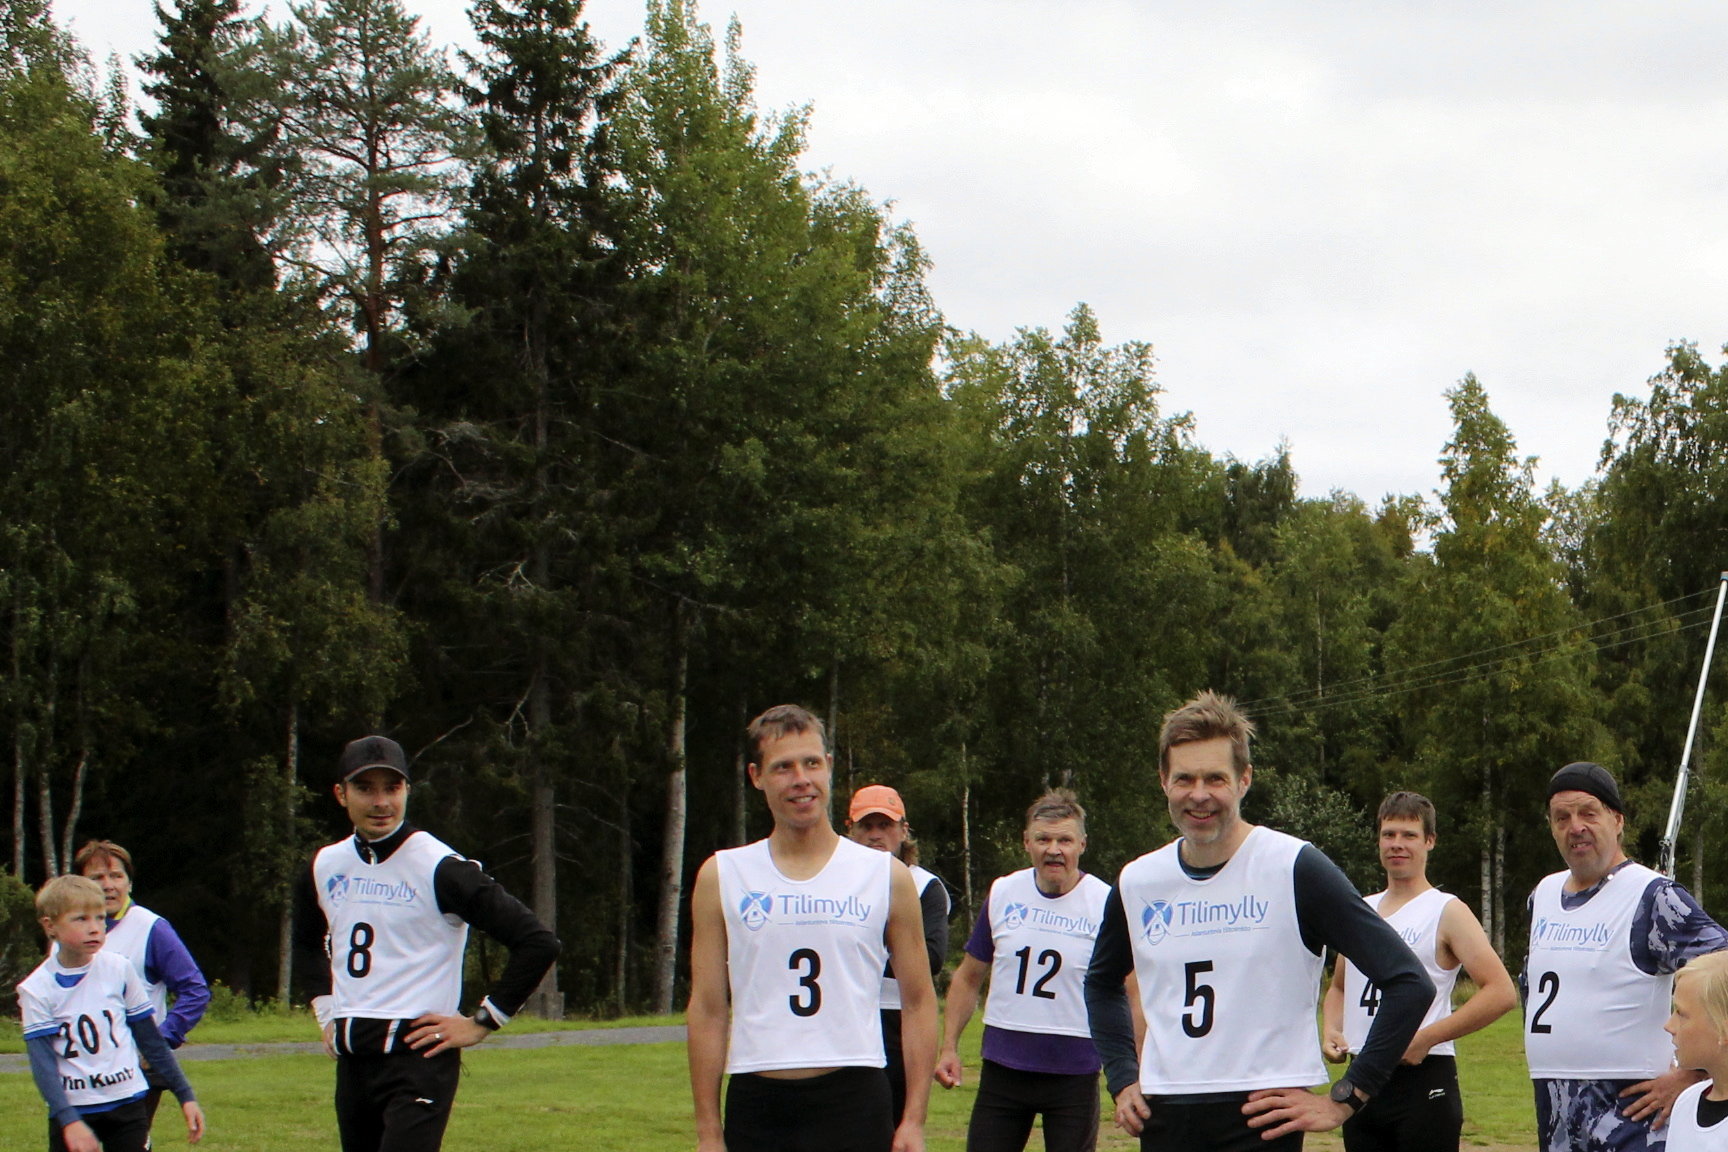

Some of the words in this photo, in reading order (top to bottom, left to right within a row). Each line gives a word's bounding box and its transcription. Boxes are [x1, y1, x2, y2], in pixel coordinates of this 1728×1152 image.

[352, 877, 417, 902] Tilimylly
[778, 894, 871, 921] Tilimylly
[1032, 907, 1097, 934] Tilimylly
[1177, 895, 1269, 925] Tilimylly
[347, 921, 374, 979] 8
[1547, 922, 1614, 947] Tilimylly
[788, 947, 822, 1018] 3
[1015, 945, 1063, 1000] 12
[1181, 959, 1215, 1039] 5
[1360, 978, 1379, 1017] 4
[1530, 970, 1560, 1034] 2
